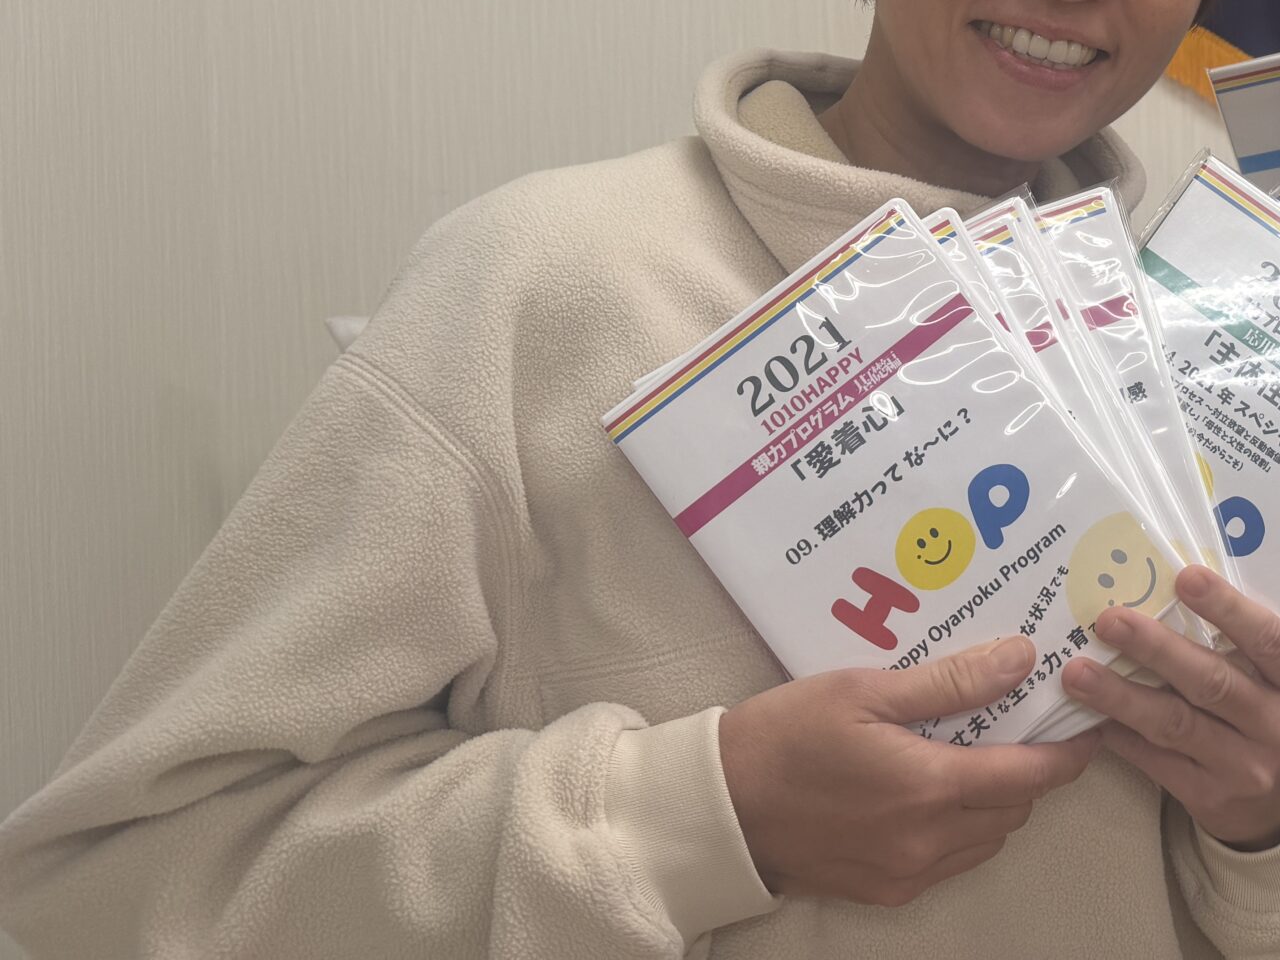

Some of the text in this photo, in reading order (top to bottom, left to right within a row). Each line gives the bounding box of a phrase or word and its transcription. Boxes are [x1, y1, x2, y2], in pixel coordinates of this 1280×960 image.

[737, 317, 852, 417] 2021
[760, 347, 864, 436] 1010HAPPY
[751, 392, 855, 476] 親力プログラム
[791, 395, 905, 481] 「愛着心」
[785, 539, 819, 565] 09.
[882, 522, 1066, 671] appy Oyaryoku Program
